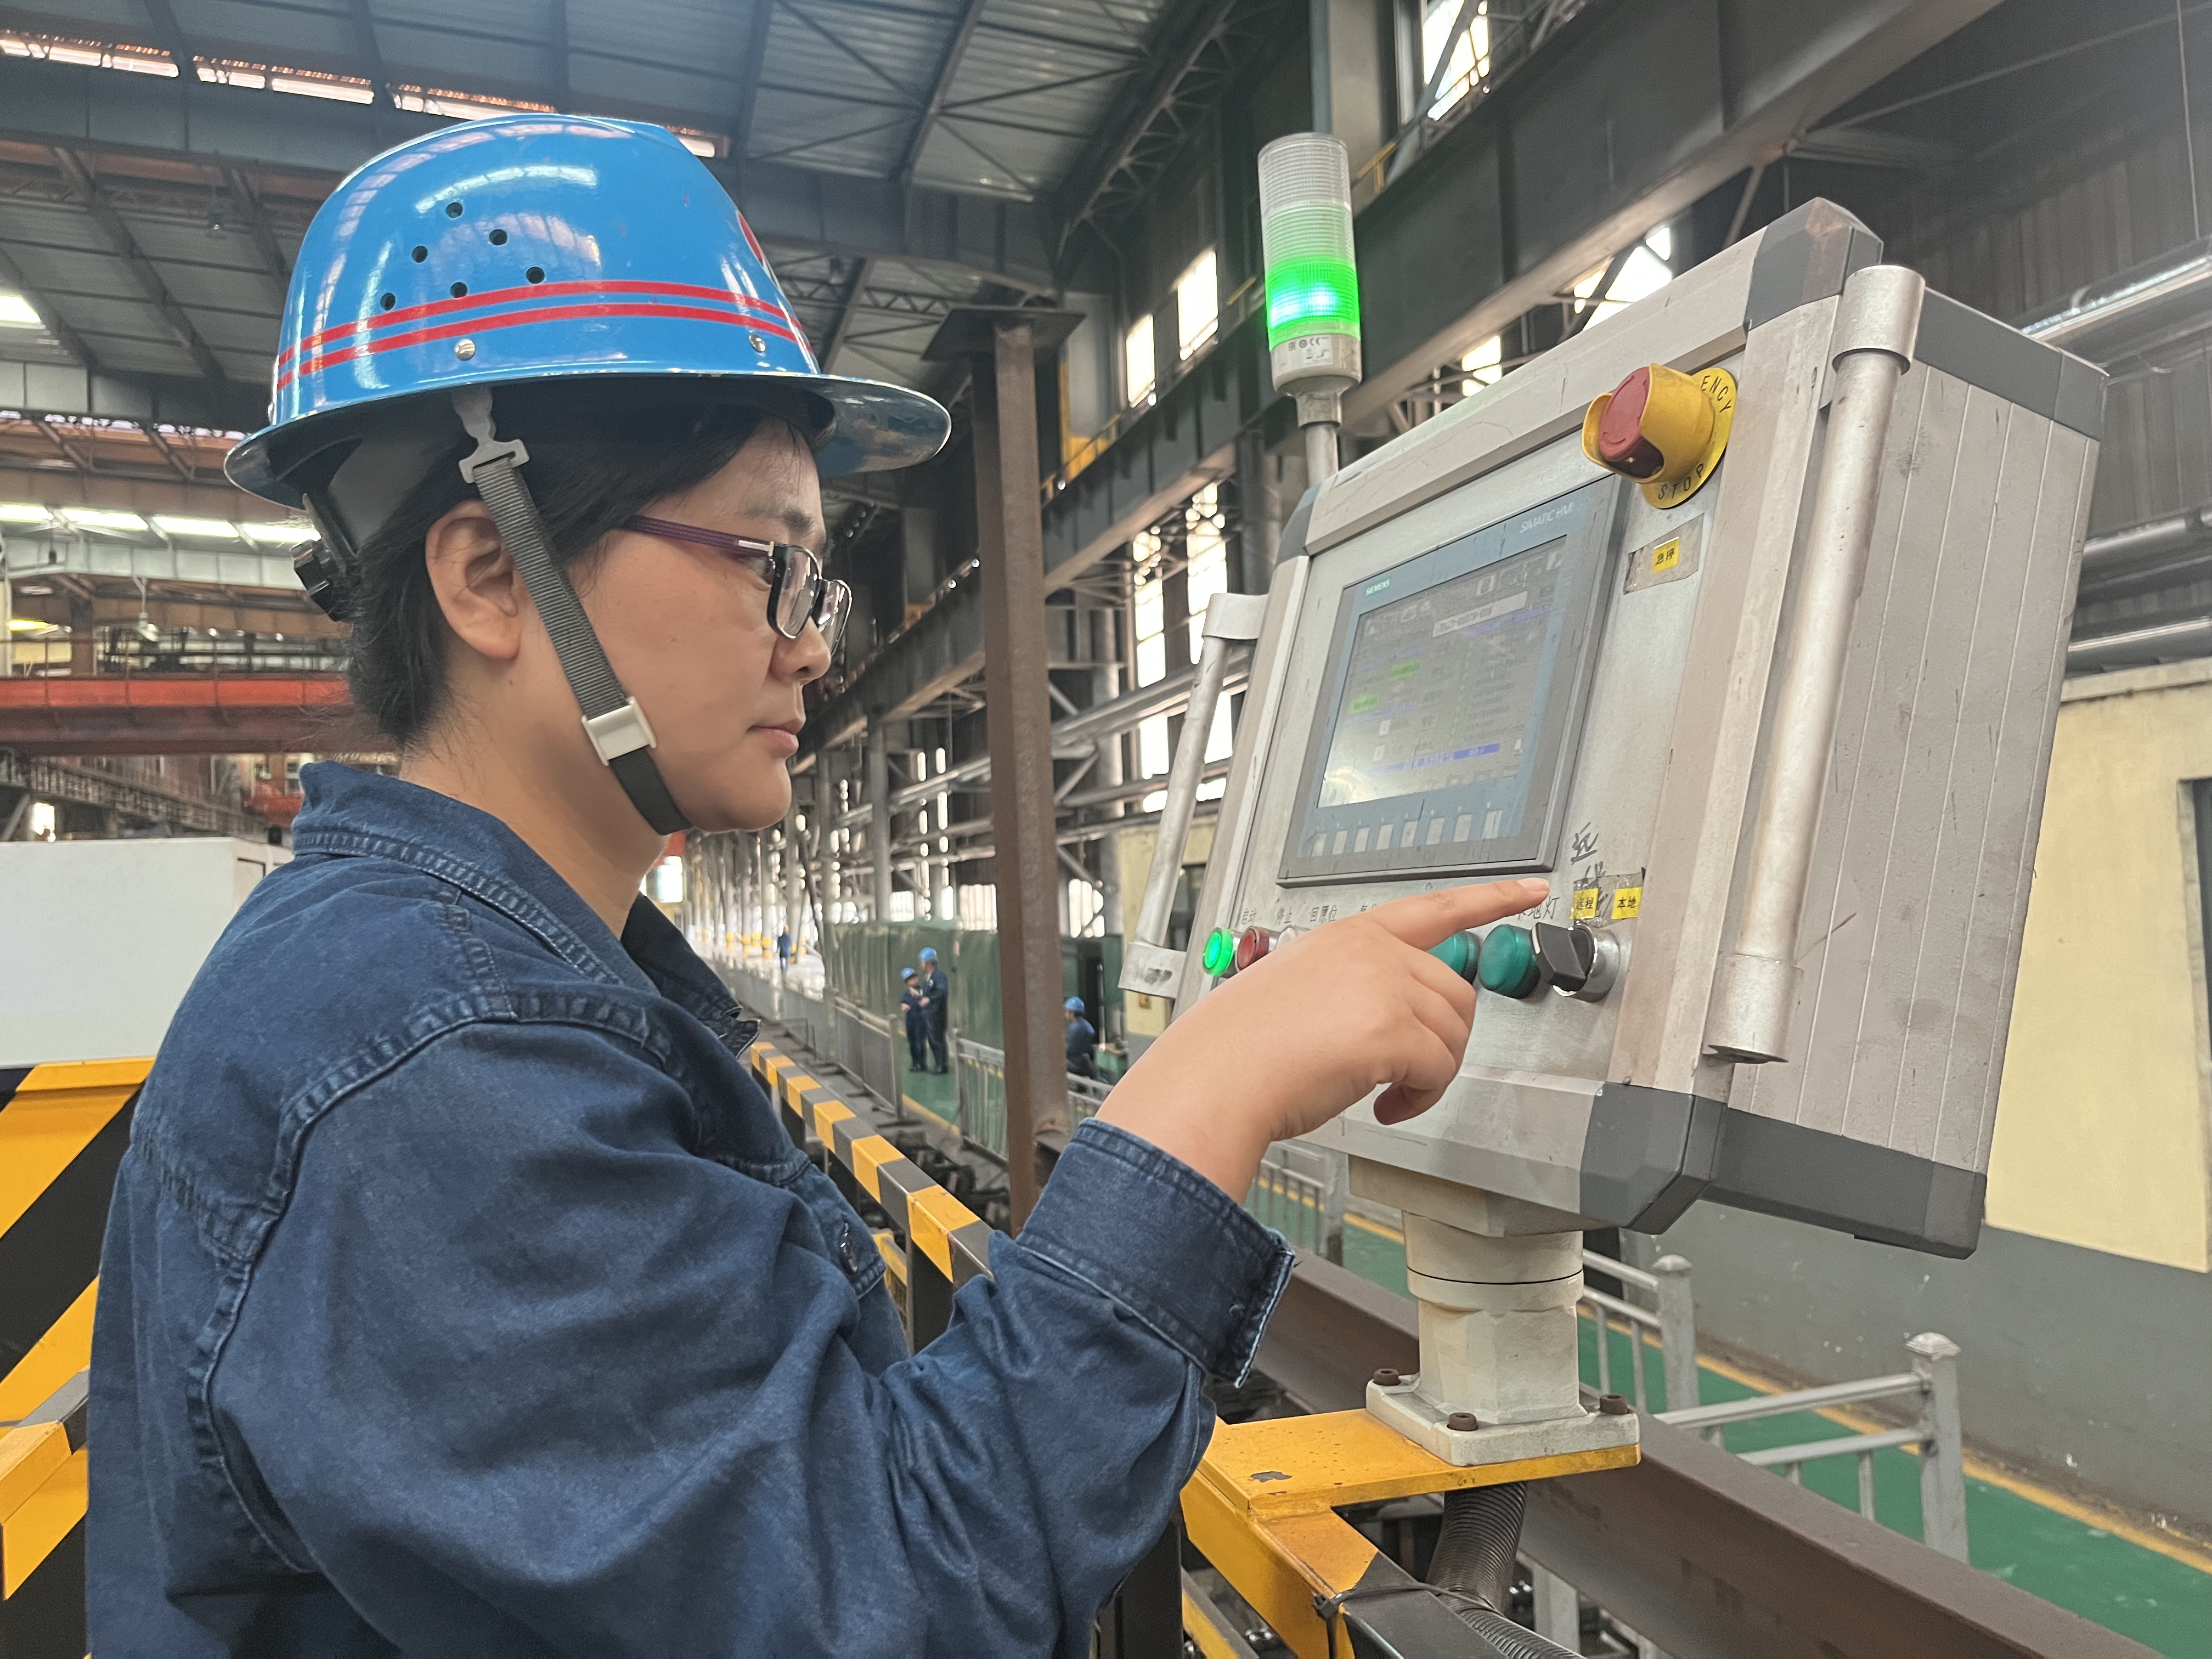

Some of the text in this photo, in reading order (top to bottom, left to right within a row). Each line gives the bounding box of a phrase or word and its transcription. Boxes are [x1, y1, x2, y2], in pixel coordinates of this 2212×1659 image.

[1658, 463, 1705, 500] STOP
[1520, 509, 1555, 533] SIMATIC
[1654, 548, 1675, 566] 急停
[1617, 895, 1637, 909] 本地
[1241, 907, 1257, 926] 启动
[1275, 906, 1293, 925] 停止
[1310, 905, 1338, 923] 回原位
